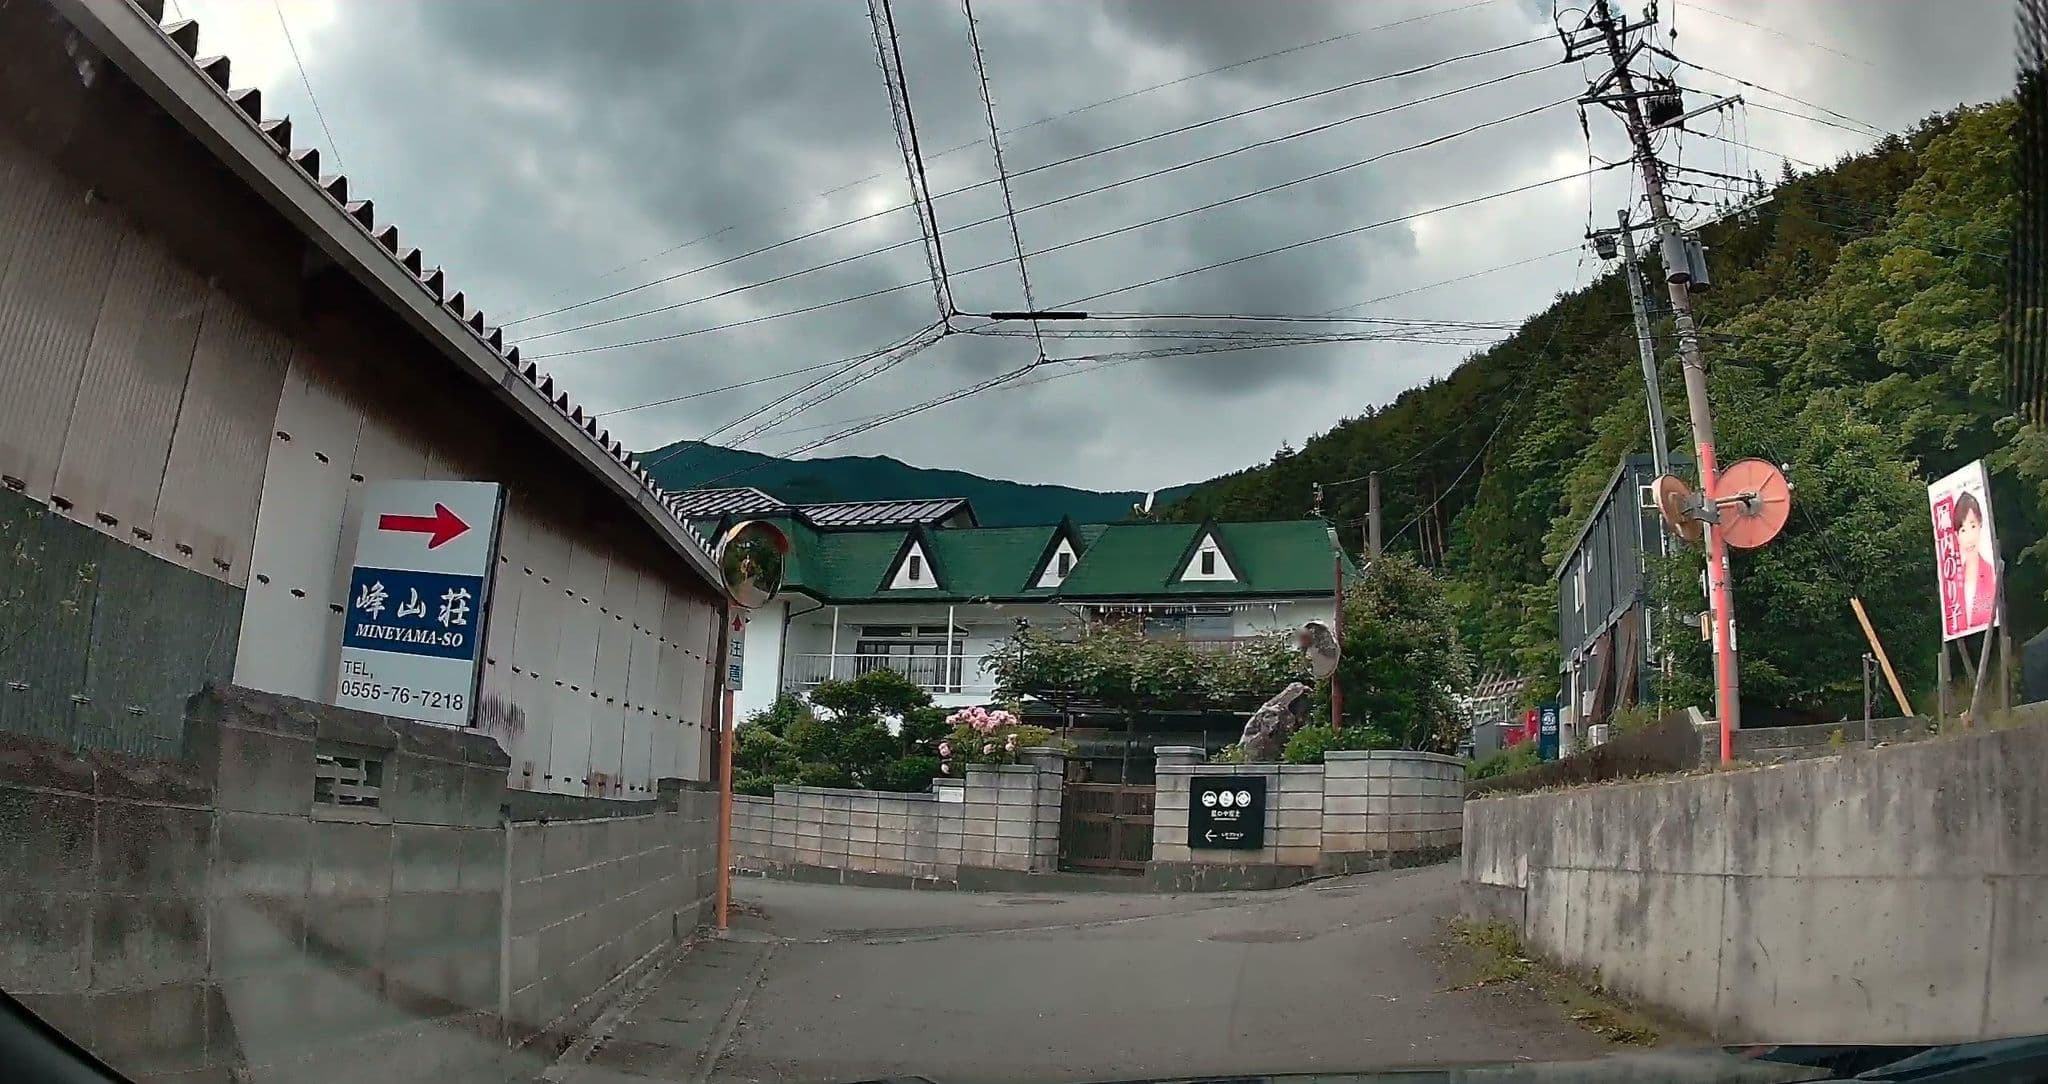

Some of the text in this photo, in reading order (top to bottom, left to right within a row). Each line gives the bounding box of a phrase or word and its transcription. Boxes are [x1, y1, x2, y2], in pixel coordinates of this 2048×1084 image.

[356, 580, 472, 627] 峰山荘
[355, 623, 463, 647] MINEYAMA-SO
[341, 680, 464, 711] 0555-76-7218
